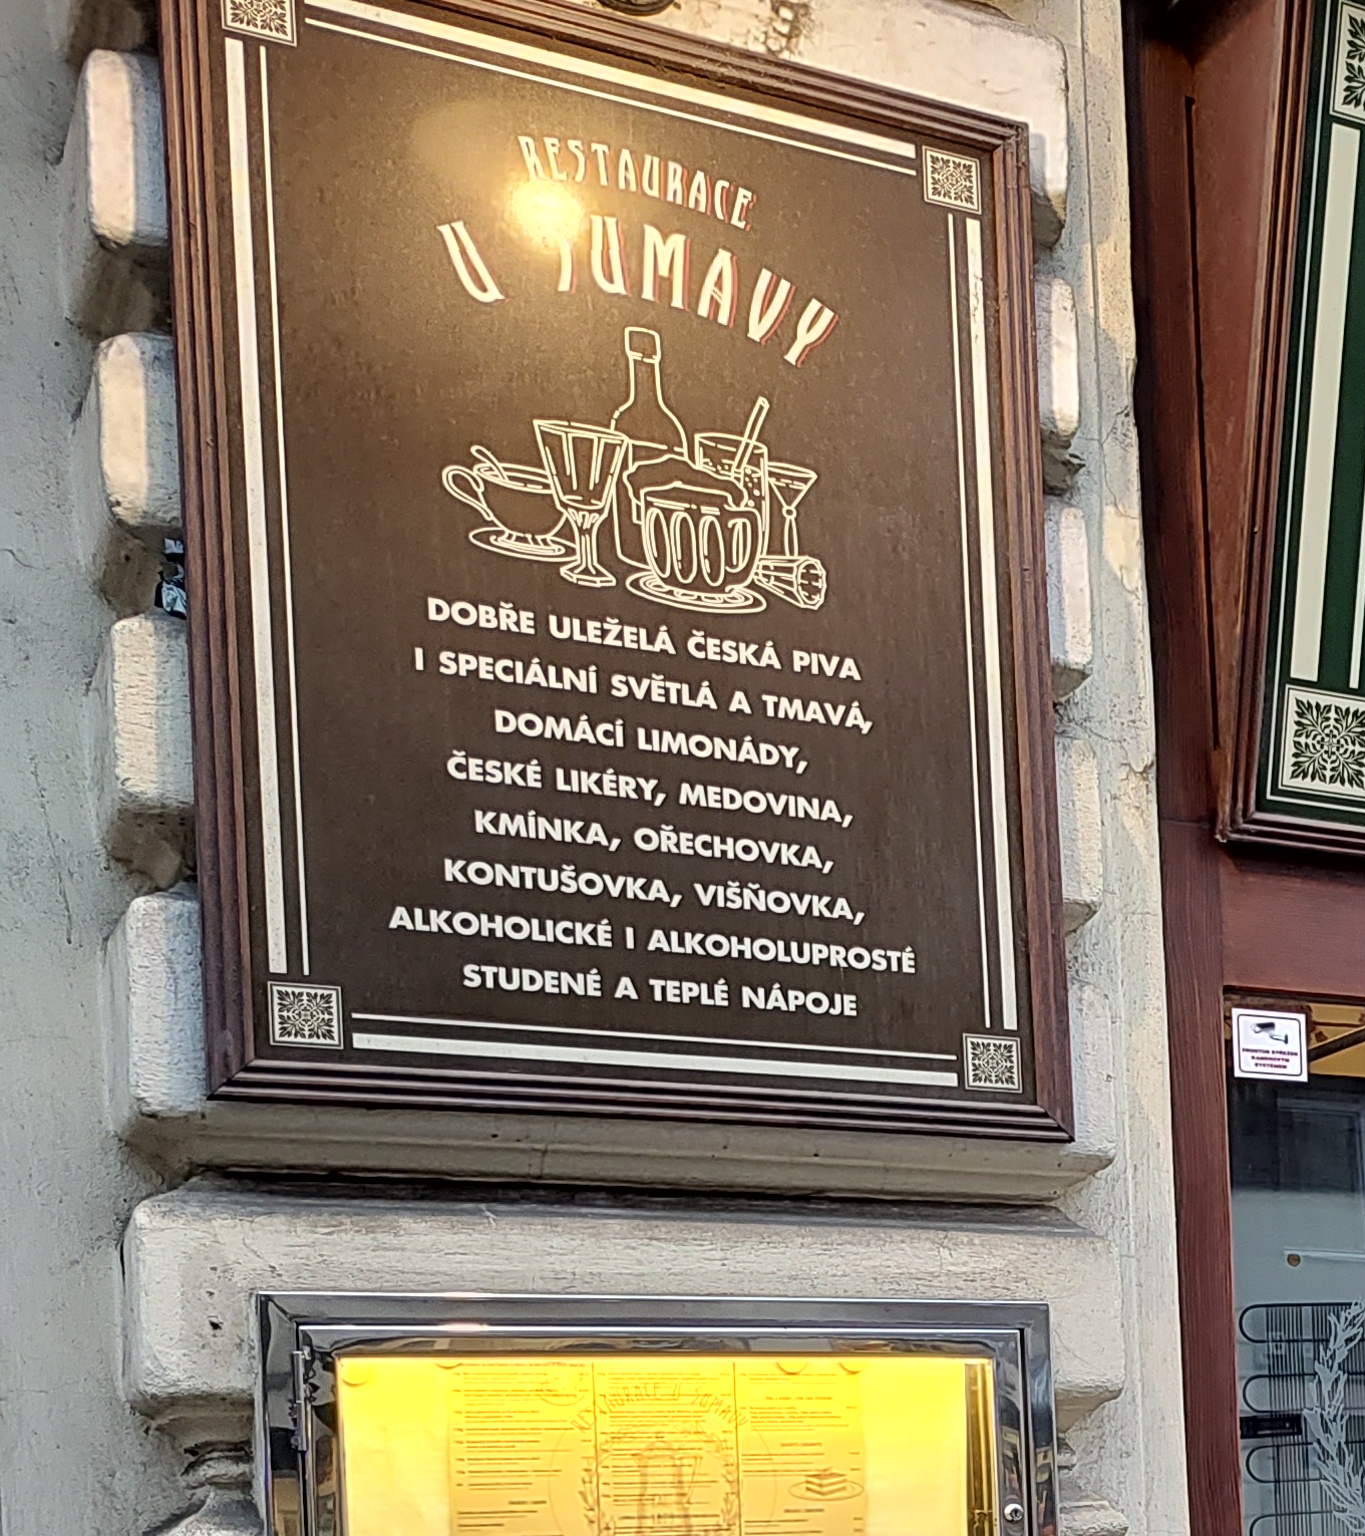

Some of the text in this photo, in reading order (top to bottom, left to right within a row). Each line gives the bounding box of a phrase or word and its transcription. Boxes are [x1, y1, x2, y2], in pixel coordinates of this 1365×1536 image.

[518, 135, 756, 230] RESTAURACE
[436, 219, 507, 303] U
[427, 597, 861, 681] DOBŘE ULEŽELÁ ČESKÁ PIVA
[415, 648, 873, 734] I SPECIÁLNÍ SVĚTLÁ A TMAVÁ,
[494, 709, 808, 774] DOMÁCÍ LIMONÁDY,
[447, 750, 853, 828] ČESKÉ LIKÉRY, MEDOVINA,
[475, 809, 834, 874] KMÍNKA, OŘECHOVKA,
[445, 859, 865, 926] KONTUŠOVKA, VIŠŇOVKA,
[389, 906, 916, 973] ALKOHOLICKÉ I ALKOHOLUPROSTÉ
[463, 964, 858, 1017] STUDENÉ A TEPLÉ NÁPOJE
